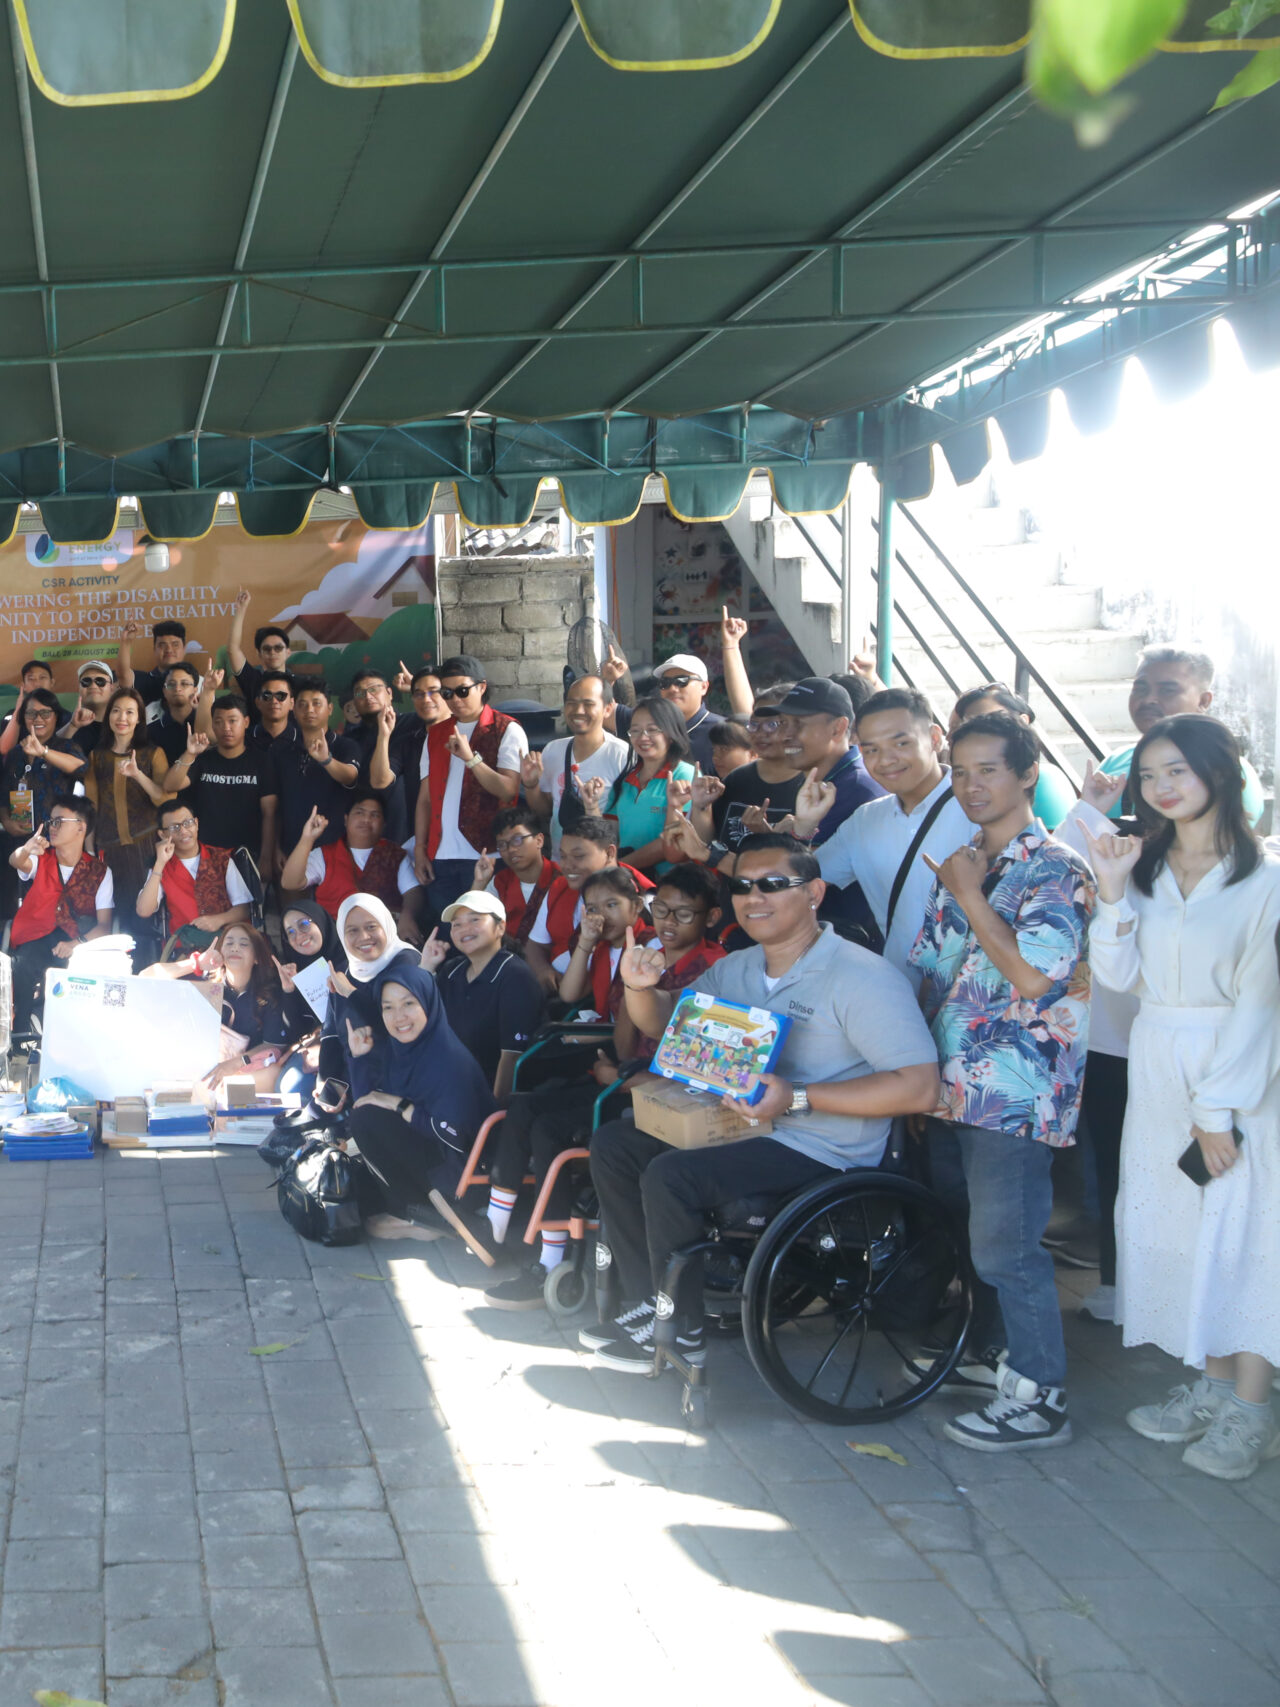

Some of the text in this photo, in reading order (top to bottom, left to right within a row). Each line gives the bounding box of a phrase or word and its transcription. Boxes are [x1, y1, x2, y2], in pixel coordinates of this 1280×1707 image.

[41, 575, 120, 588] CSR ACTIVITY
[75, 590, 112, 605] THE
[117, 585, 220, 604] DISABILITY
[46, 610, 73, 625] TO
[78, 606, 145, 623] FOSTER
[150, 602, 239, 620] CREATIVE
[11, 623, 154, 644] INDEPENDENE
[73, 648, 104, 656] AUGUST
[201, 773, 258, 785] #NOSTIGMA
